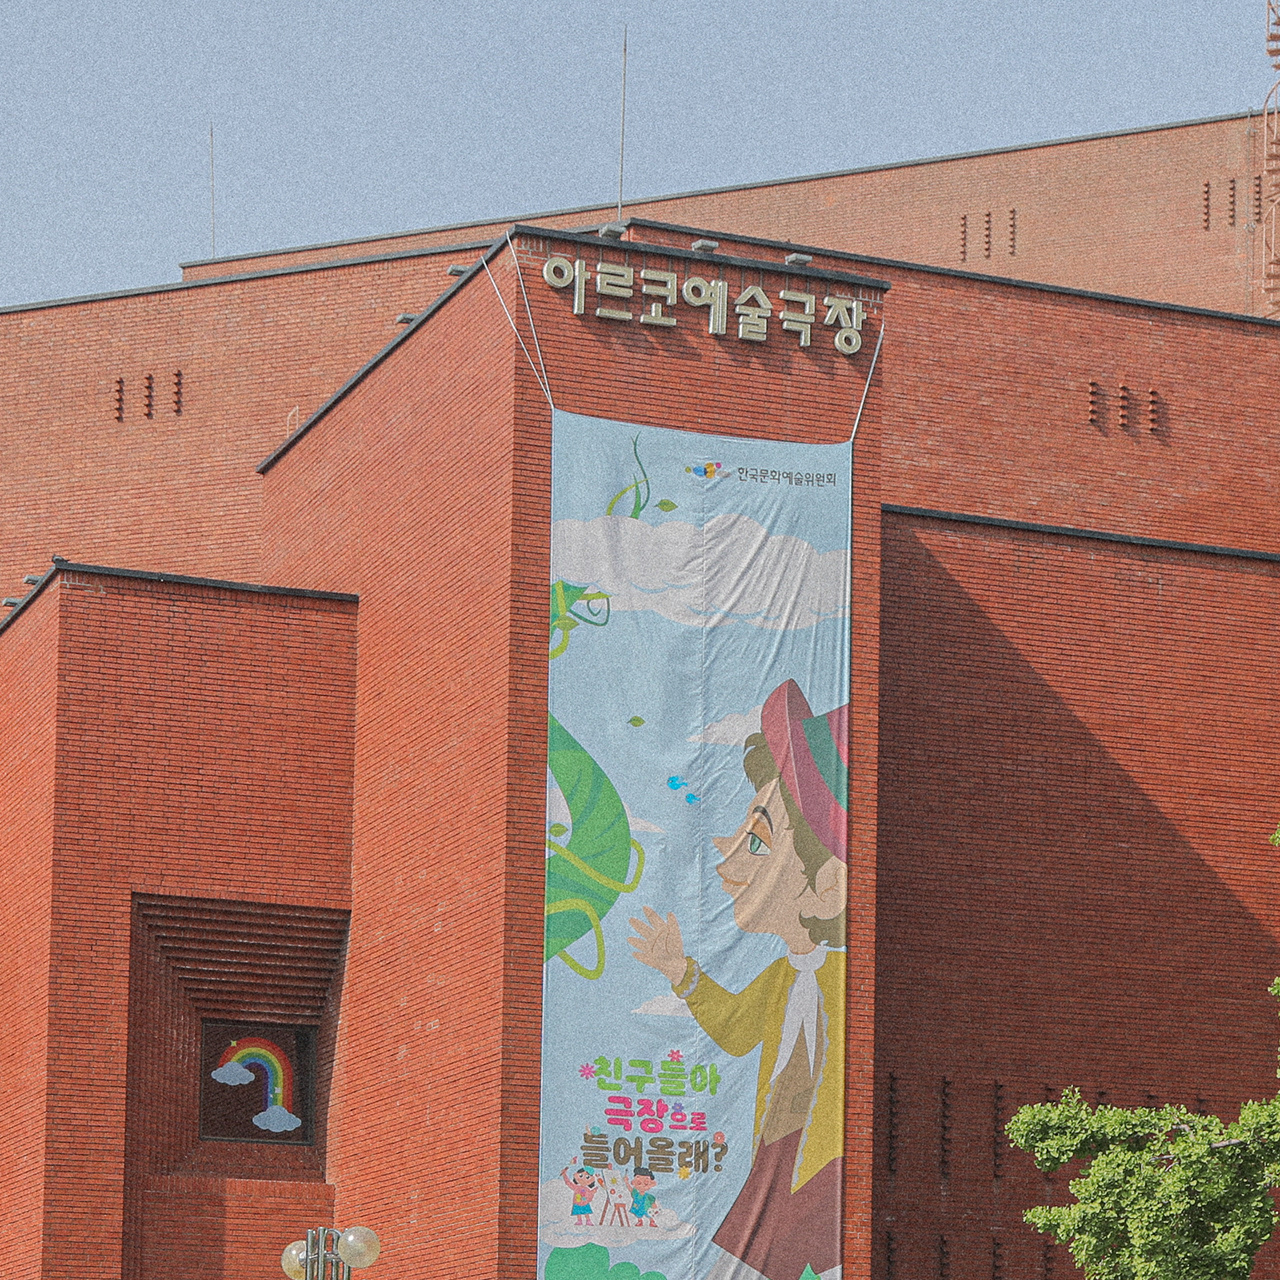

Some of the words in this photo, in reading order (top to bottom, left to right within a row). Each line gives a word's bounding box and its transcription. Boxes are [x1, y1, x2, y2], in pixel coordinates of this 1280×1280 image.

[543, 256, 867, 355] 아르코예술극장
[737, 465, 837, 487] 한국문화예술위원회
[591, 1054, 721, 1097] 친구들아
[604, 1095, 708, 1132] 극장으로
[580, 1132, 729, 1174] 들어올래?
